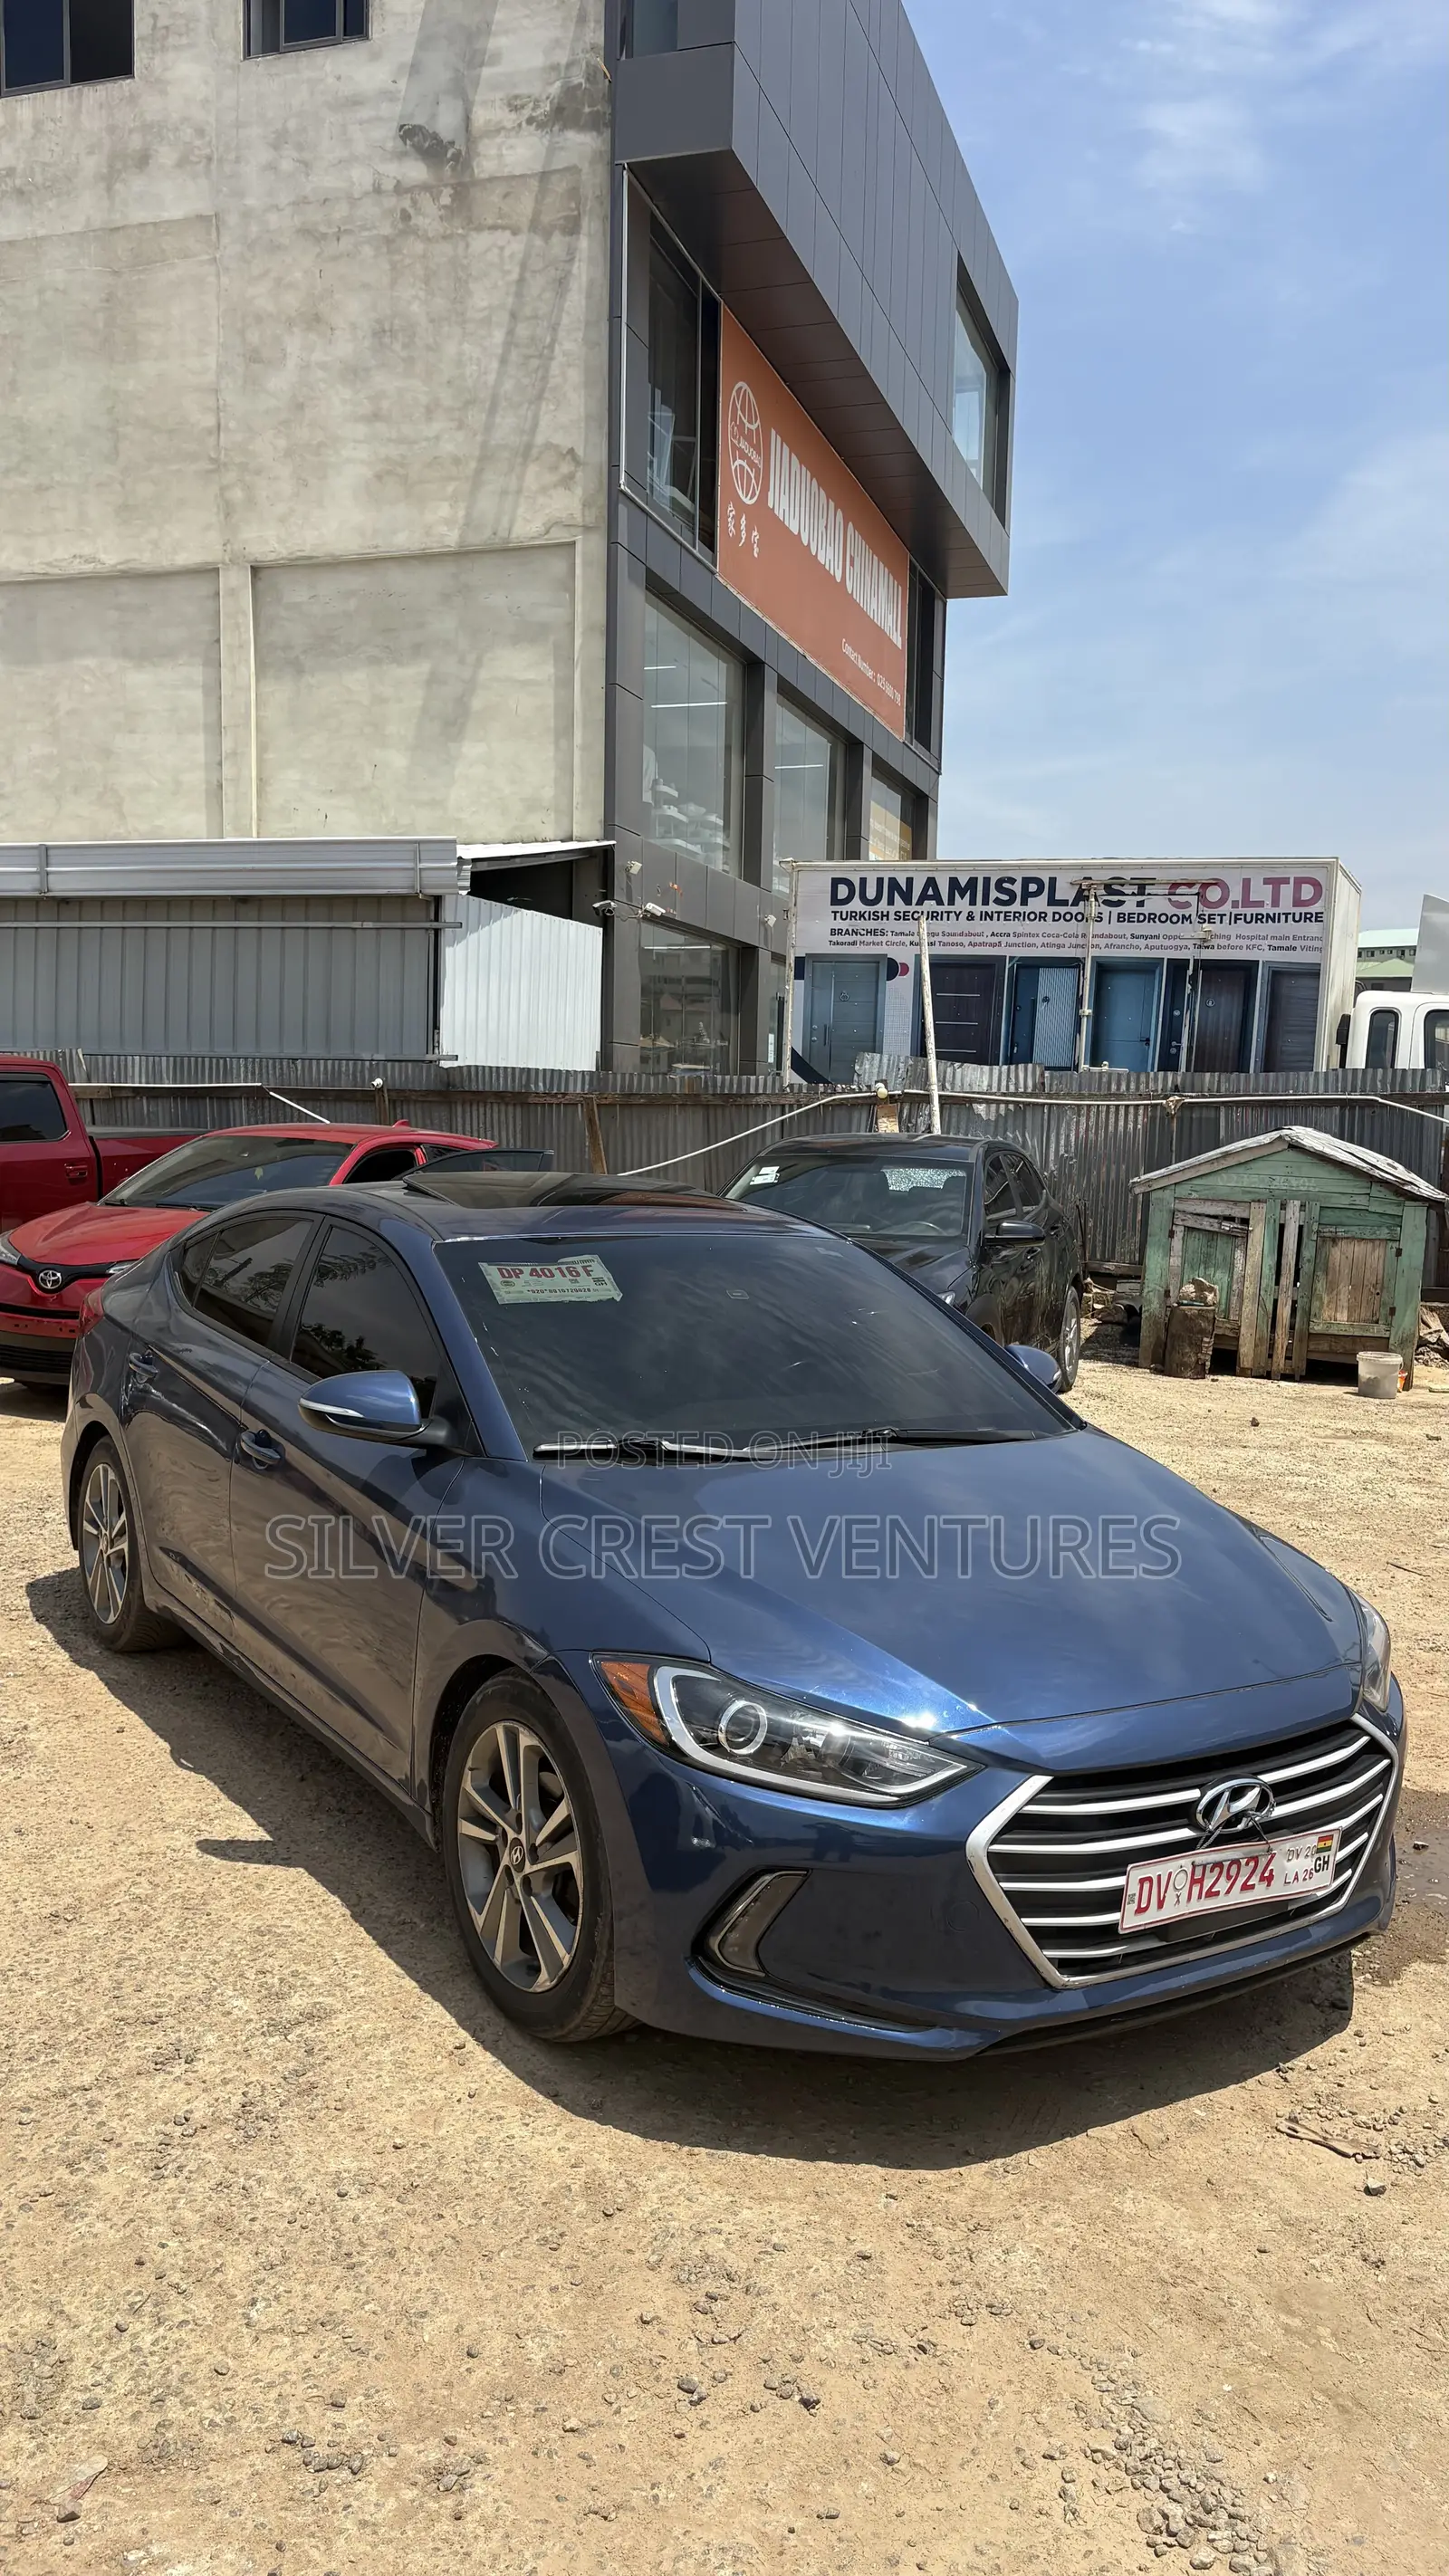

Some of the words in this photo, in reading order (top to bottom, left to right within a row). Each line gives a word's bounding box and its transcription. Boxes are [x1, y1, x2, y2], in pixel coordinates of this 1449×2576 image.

[768, 427, 844, 582] JIADUOBAO
[846, 522, 902, 650] CHINAMALL
[842, 638, 858, 666] Contact
[830, 876, 1156, 907] DUNAMISPLAST
[1167, 876, 1323, 909] CO.LTD
[831, 910, 889, 922] TURKISH
[893, 910, 963, 922] SECURITY
[966, 910, 975, 922] &
[979, 910, 1047, 923] INTERIOR
[1051, 912, 1103, 923] DOOS
[1117, 912, 1192, 924] BEDROOM
[830, 928, 888, 936] BRANCHES:
[1235, 934, 1268, 942] Hospital
[1144, 943, 1190, 952] Aputuogya,
[496, 1267, 524, 1279] DP
[581, 1265, 594, 1277] F
[1287, 1847, 1302, 1863] DV
[1314, 1854, 1330, 1873] GH
[1135, 1871, 1173, 1915] DV
[1186, 1853, 1277, 1903] H2924
[1284, 1871, 1300, 1885] LA
[1302, 1868, 1314, 1882] 26
